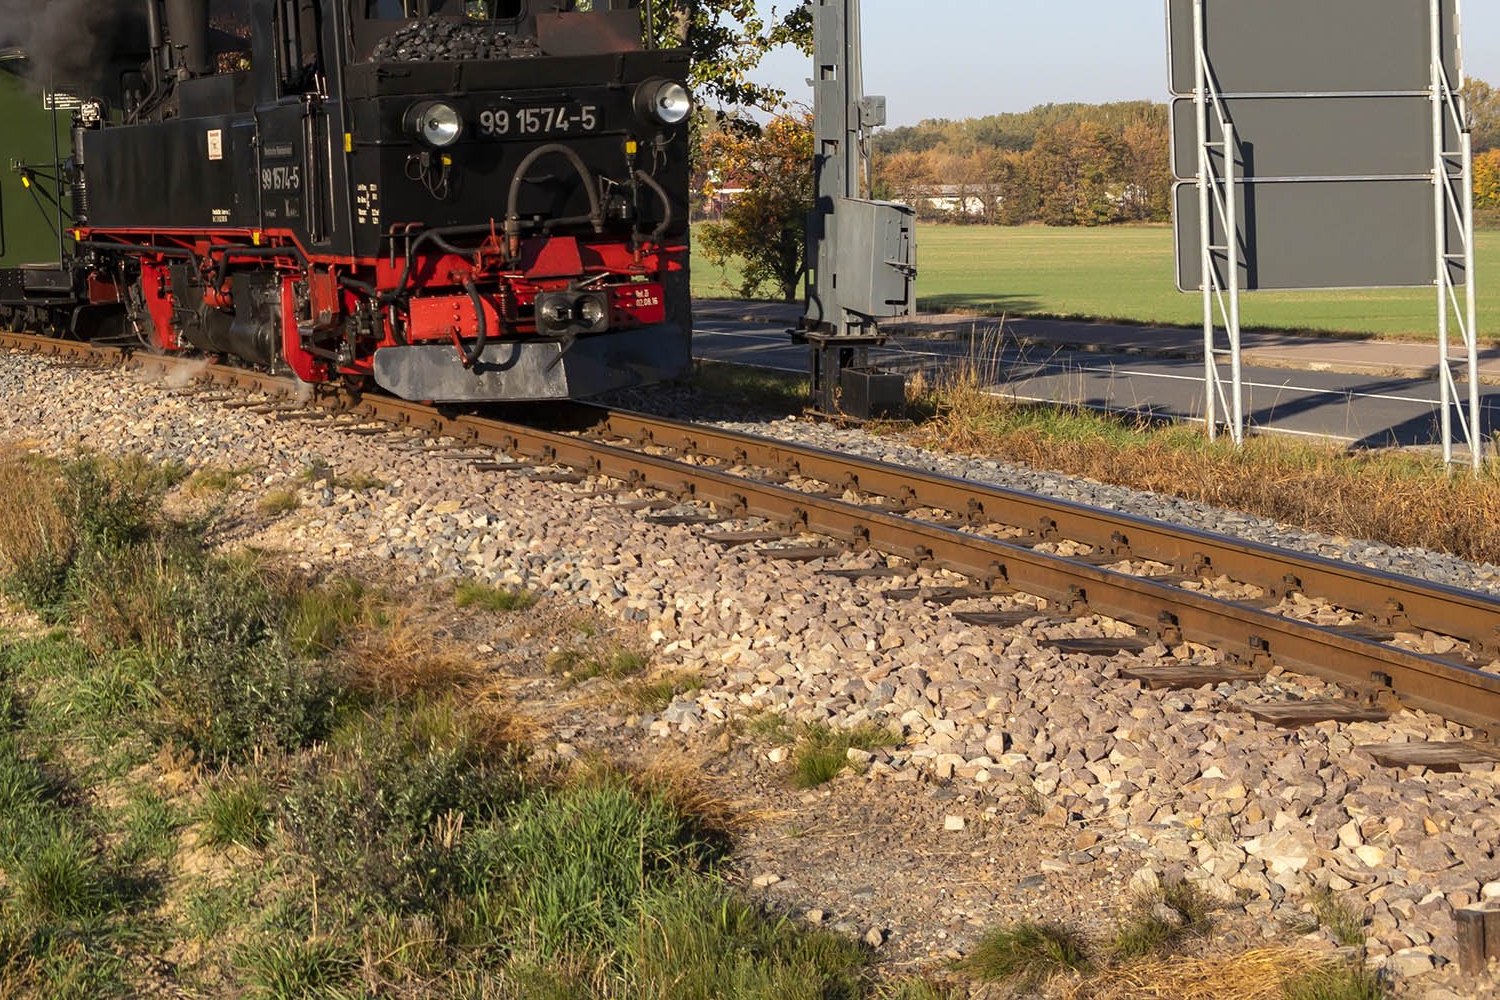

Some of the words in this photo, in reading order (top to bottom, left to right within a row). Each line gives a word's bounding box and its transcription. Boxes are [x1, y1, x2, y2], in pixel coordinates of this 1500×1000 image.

[480, 110, 509, 135] 99
[516, 105, 596, 134] 1574-5
[262, 168, 271, 190] 99
[272, 166, 300, 190] 1574-5
